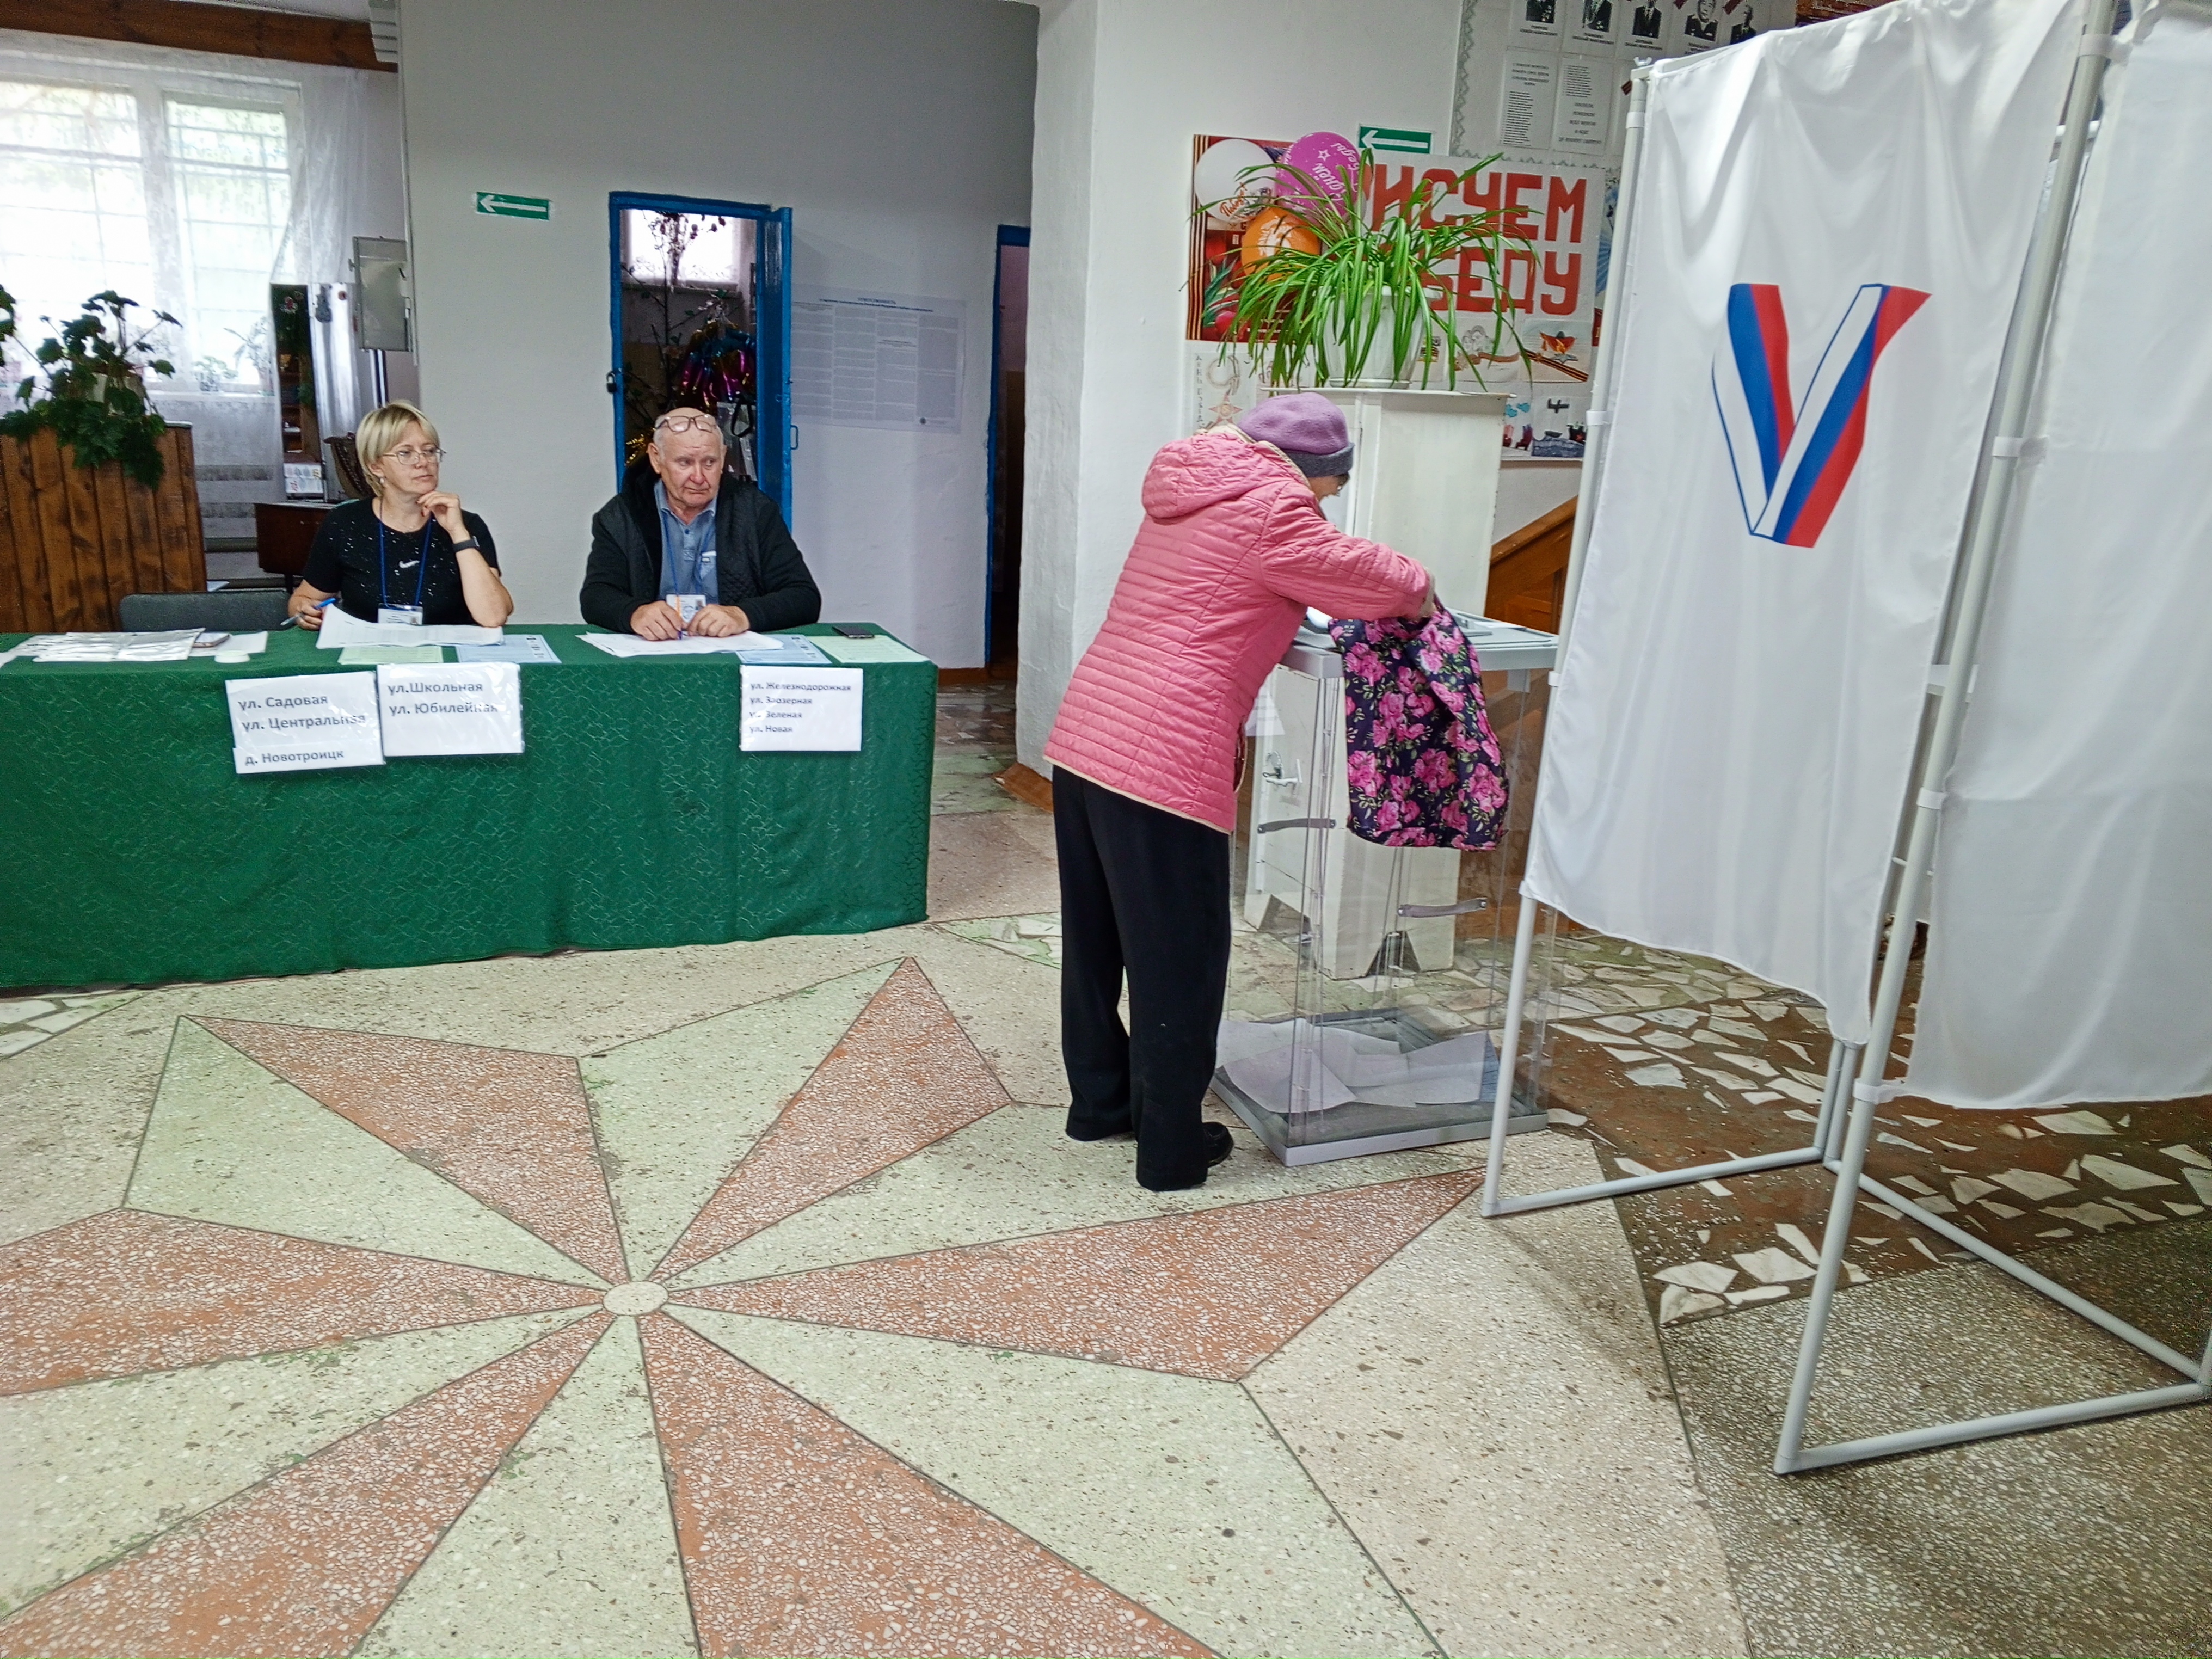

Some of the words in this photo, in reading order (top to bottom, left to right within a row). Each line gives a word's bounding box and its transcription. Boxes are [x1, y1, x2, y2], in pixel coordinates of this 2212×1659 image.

[1361, 163, 1587, 243] ИСУЕМ
[1363, 243, 1582, 316] БЕДУ
[750, 683, 764, 691] ул.
[238, 700, 262, 711] ул.
[265, 696, 329, 709] Садовая
[389, 705, 410, 717] ул.
[242, 721, 265, 732] ул.
[245, 756, 259, 766] д.
[261, 750, 345, 763] Новотроицк
